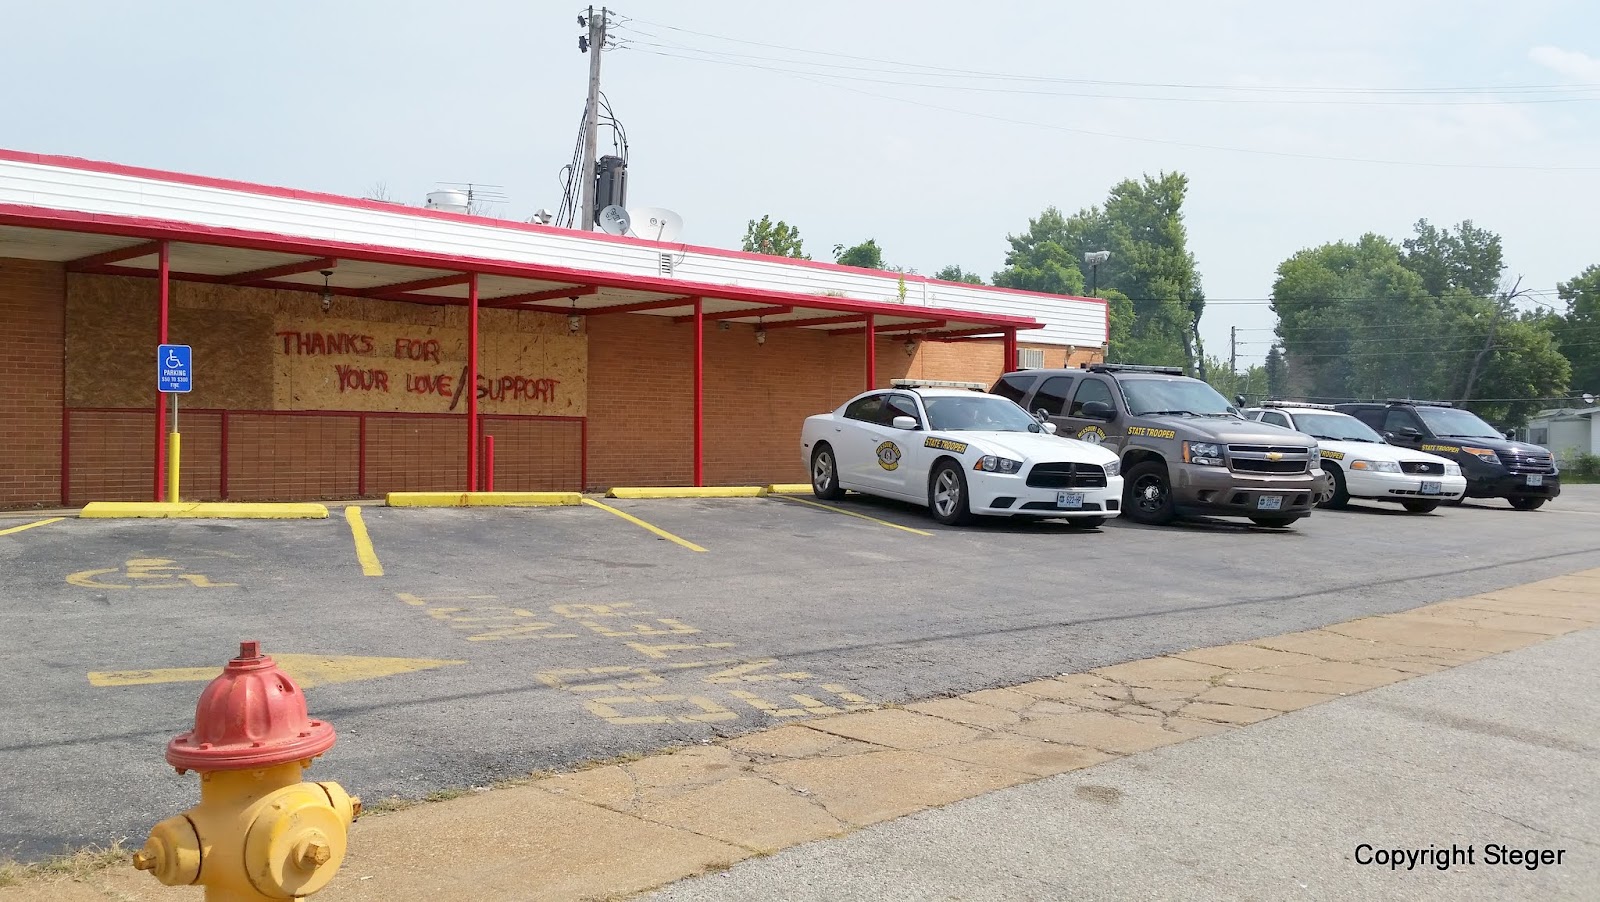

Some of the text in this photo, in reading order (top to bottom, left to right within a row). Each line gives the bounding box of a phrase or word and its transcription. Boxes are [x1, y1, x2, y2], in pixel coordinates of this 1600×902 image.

[275, 331, 441, 364] THANKS FOR
[335, 364, 389, 393] YOUR
[1127, 426, 1176, 439] STATE TROOPER
[925, 436, 967, 454] STATE TROOPER
[1436, 445, 1460, 454] TROOPER
[549, 601, 882, 718] ENTER
